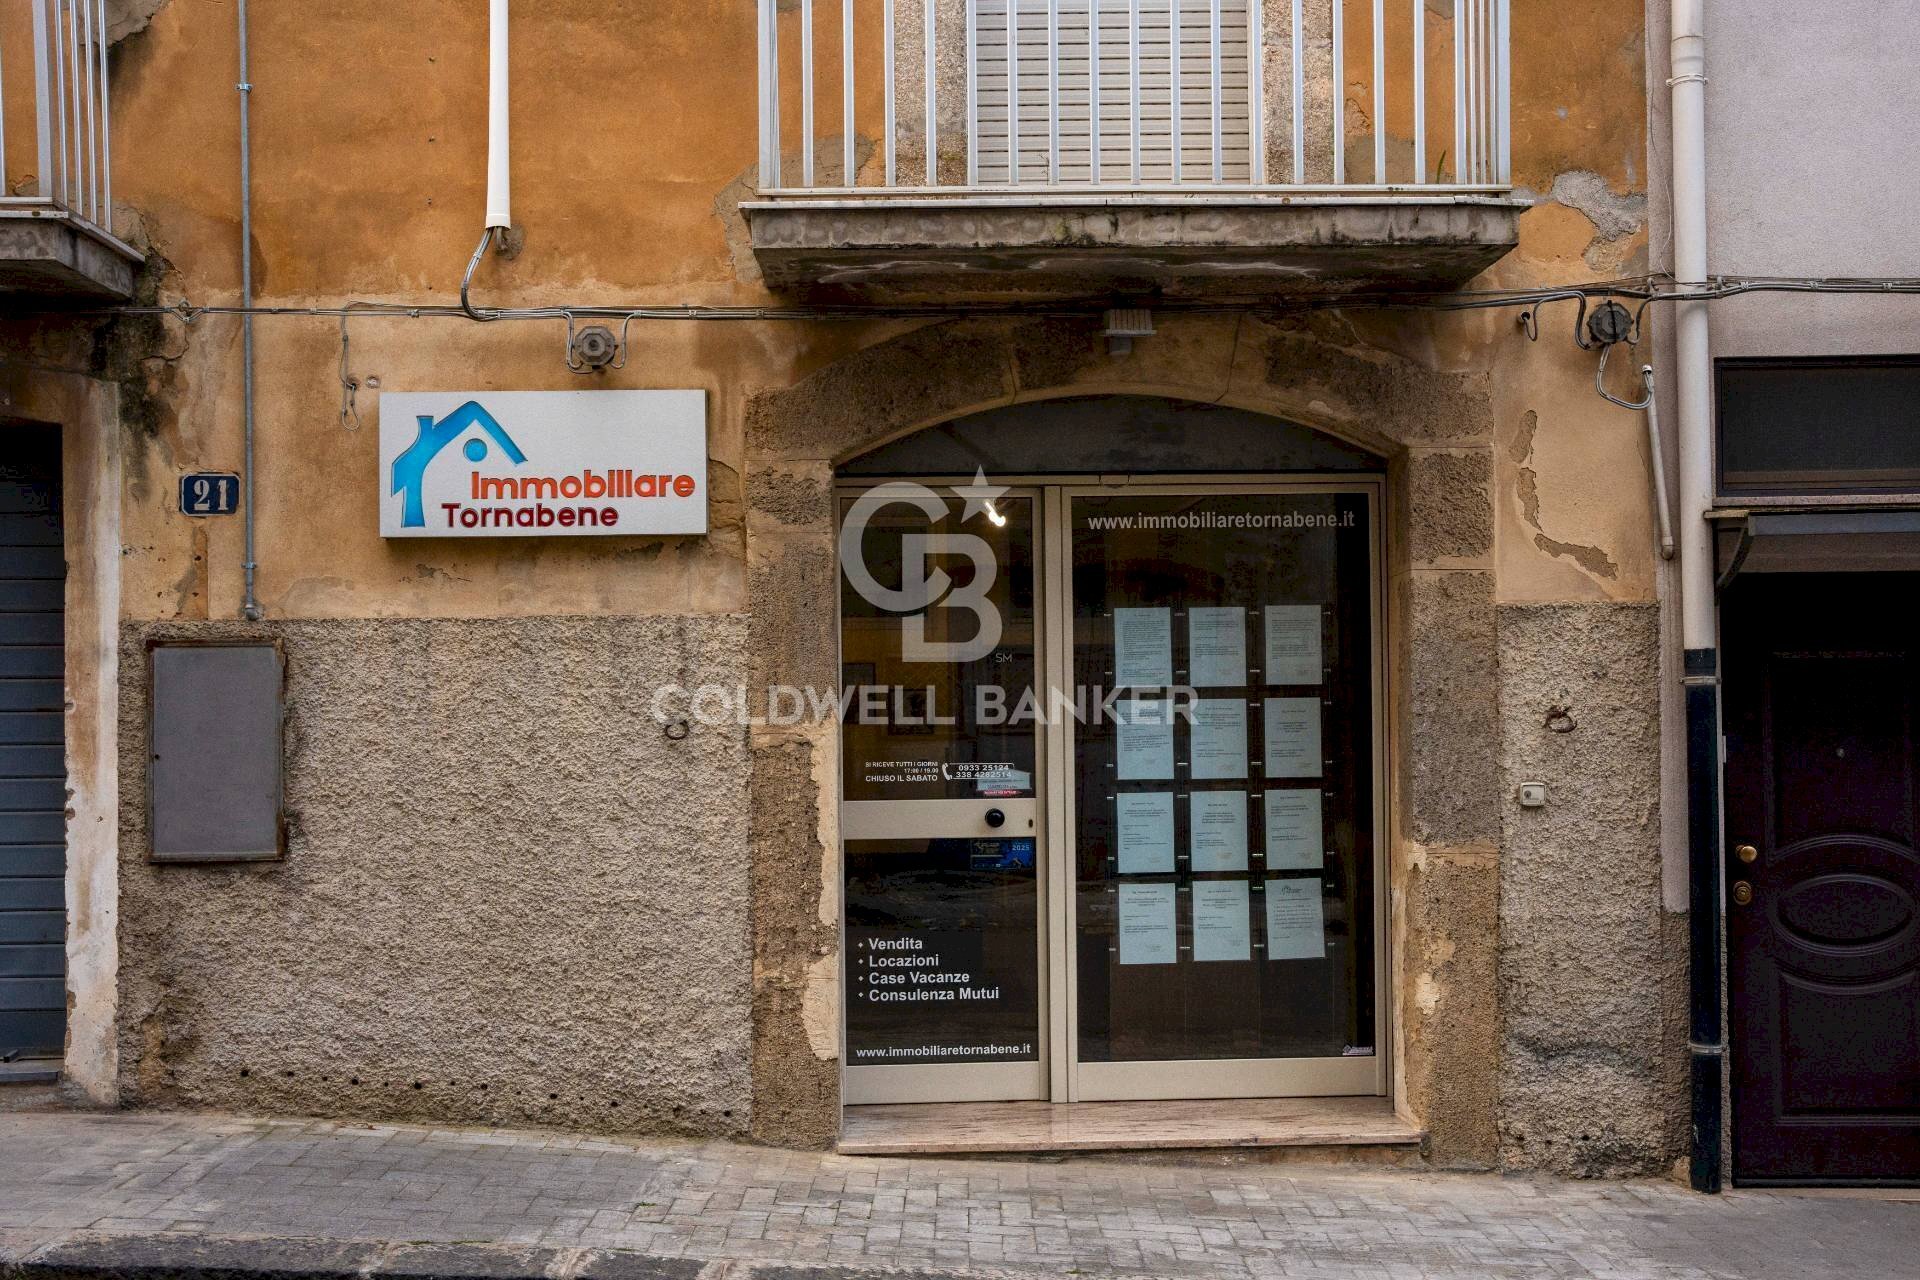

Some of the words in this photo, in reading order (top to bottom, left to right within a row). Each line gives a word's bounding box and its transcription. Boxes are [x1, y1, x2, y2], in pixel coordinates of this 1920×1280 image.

[193, 479, 229, 511] 21
[441, 503, 619, 529] Tornabene
[1087, 510, 1356, 530] www.immobiliaretornabene.it
[905, 774, 938, 782] SABATO
[868, 937, 923, 950] Vendita
[868, 954, 940, 968] Locazioni
[868, 972, 906, 985] Case
[909, 971, 970, 984] Vacanze
[868, 988, 955, 1002] Consulenza
[959, 986, 1000, 1000] Mutui
[856, 1043, 1032, 1058] www.immobiliaretornabene.it
